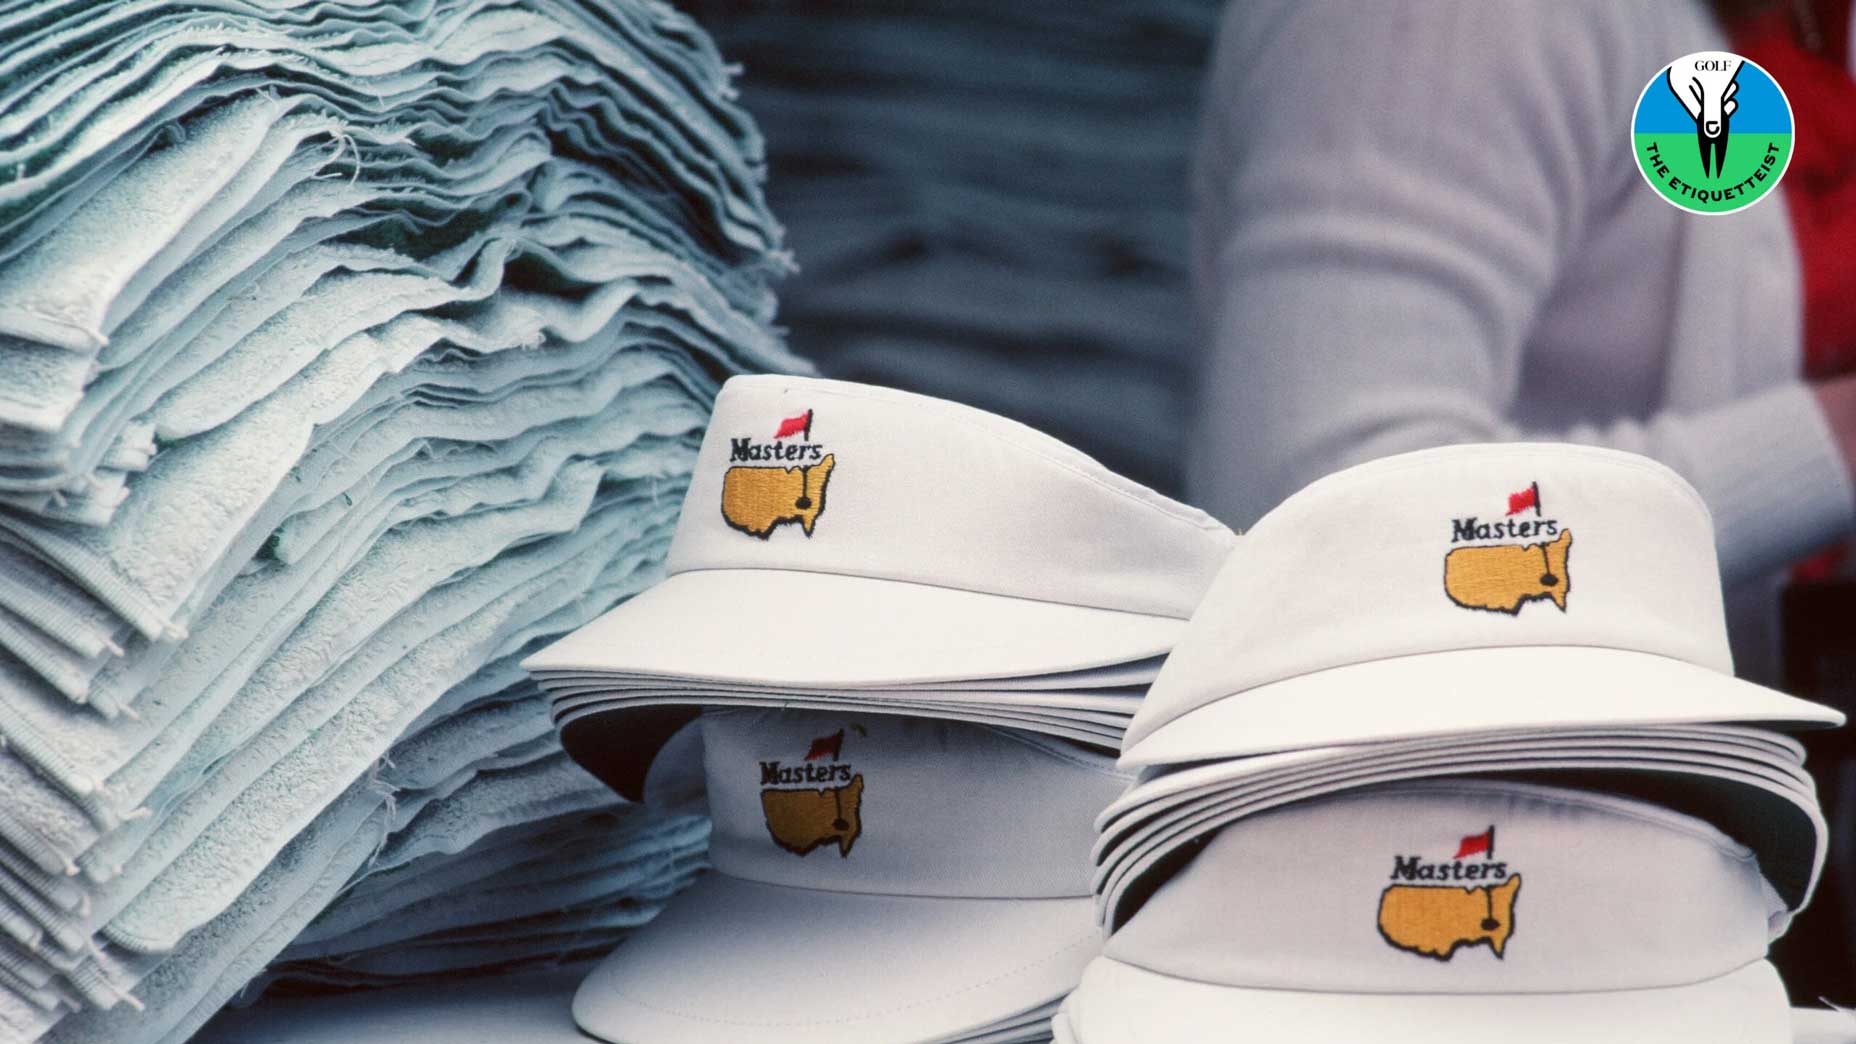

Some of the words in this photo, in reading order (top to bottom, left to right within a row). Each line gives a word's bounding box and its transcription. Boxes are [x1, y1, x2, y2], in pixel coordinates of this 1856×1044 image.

[730, 437, 822, 462] Masters
[1451, 517, 1558, 543] Masters
[759, 761, 851, 785] Masters
[1390, 854, 1507, 880] Masters
